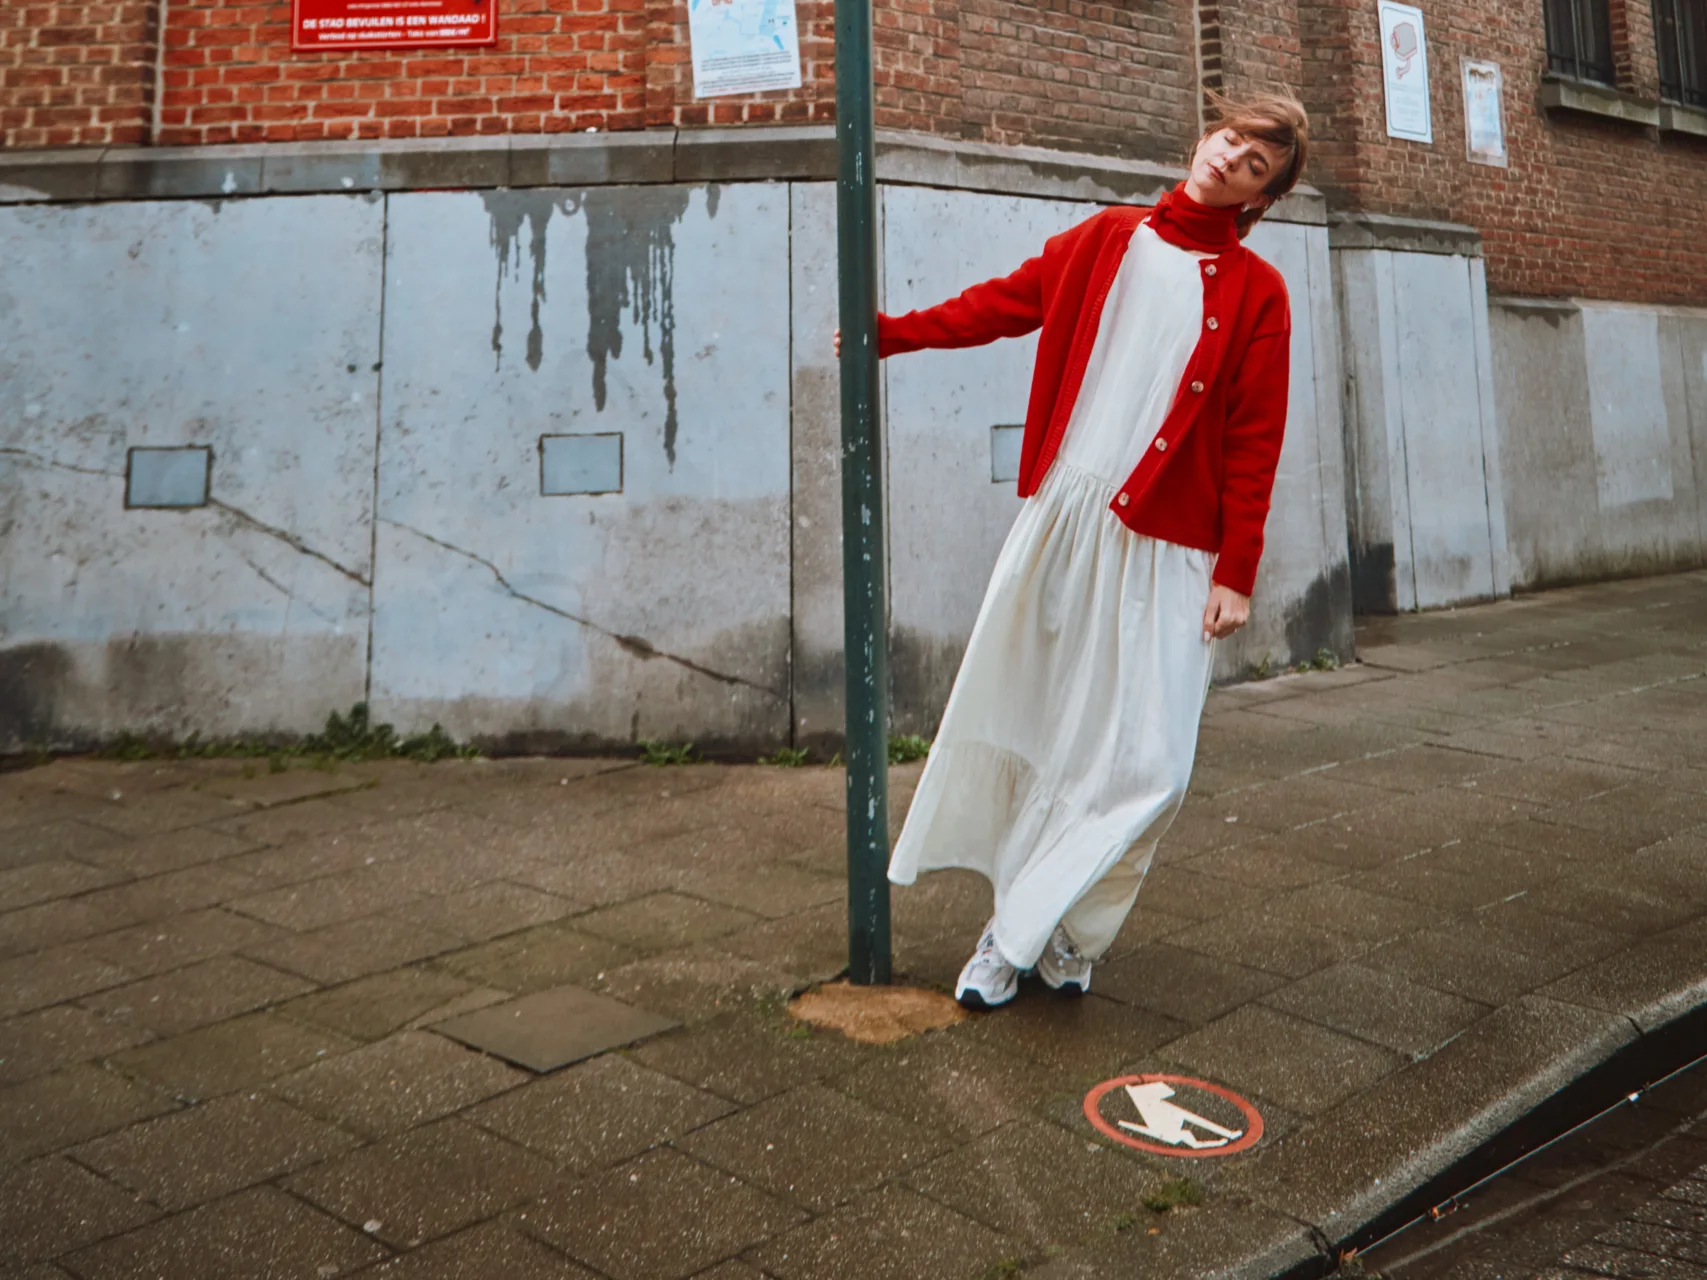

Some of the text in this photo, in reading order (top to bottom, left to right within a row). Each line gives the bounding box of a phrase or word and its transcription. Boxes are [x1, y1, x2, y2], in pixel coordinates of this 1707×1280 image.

[303, 18, 317, 29] DE
[319, 17, 344, 29] STAD
[346, 16, 393, 28] BEVUILEN
[395, 15, 405, 27] IS
[406, 15, 426, 26] EEN
[428, 13, 479, 26] WANDAAD
